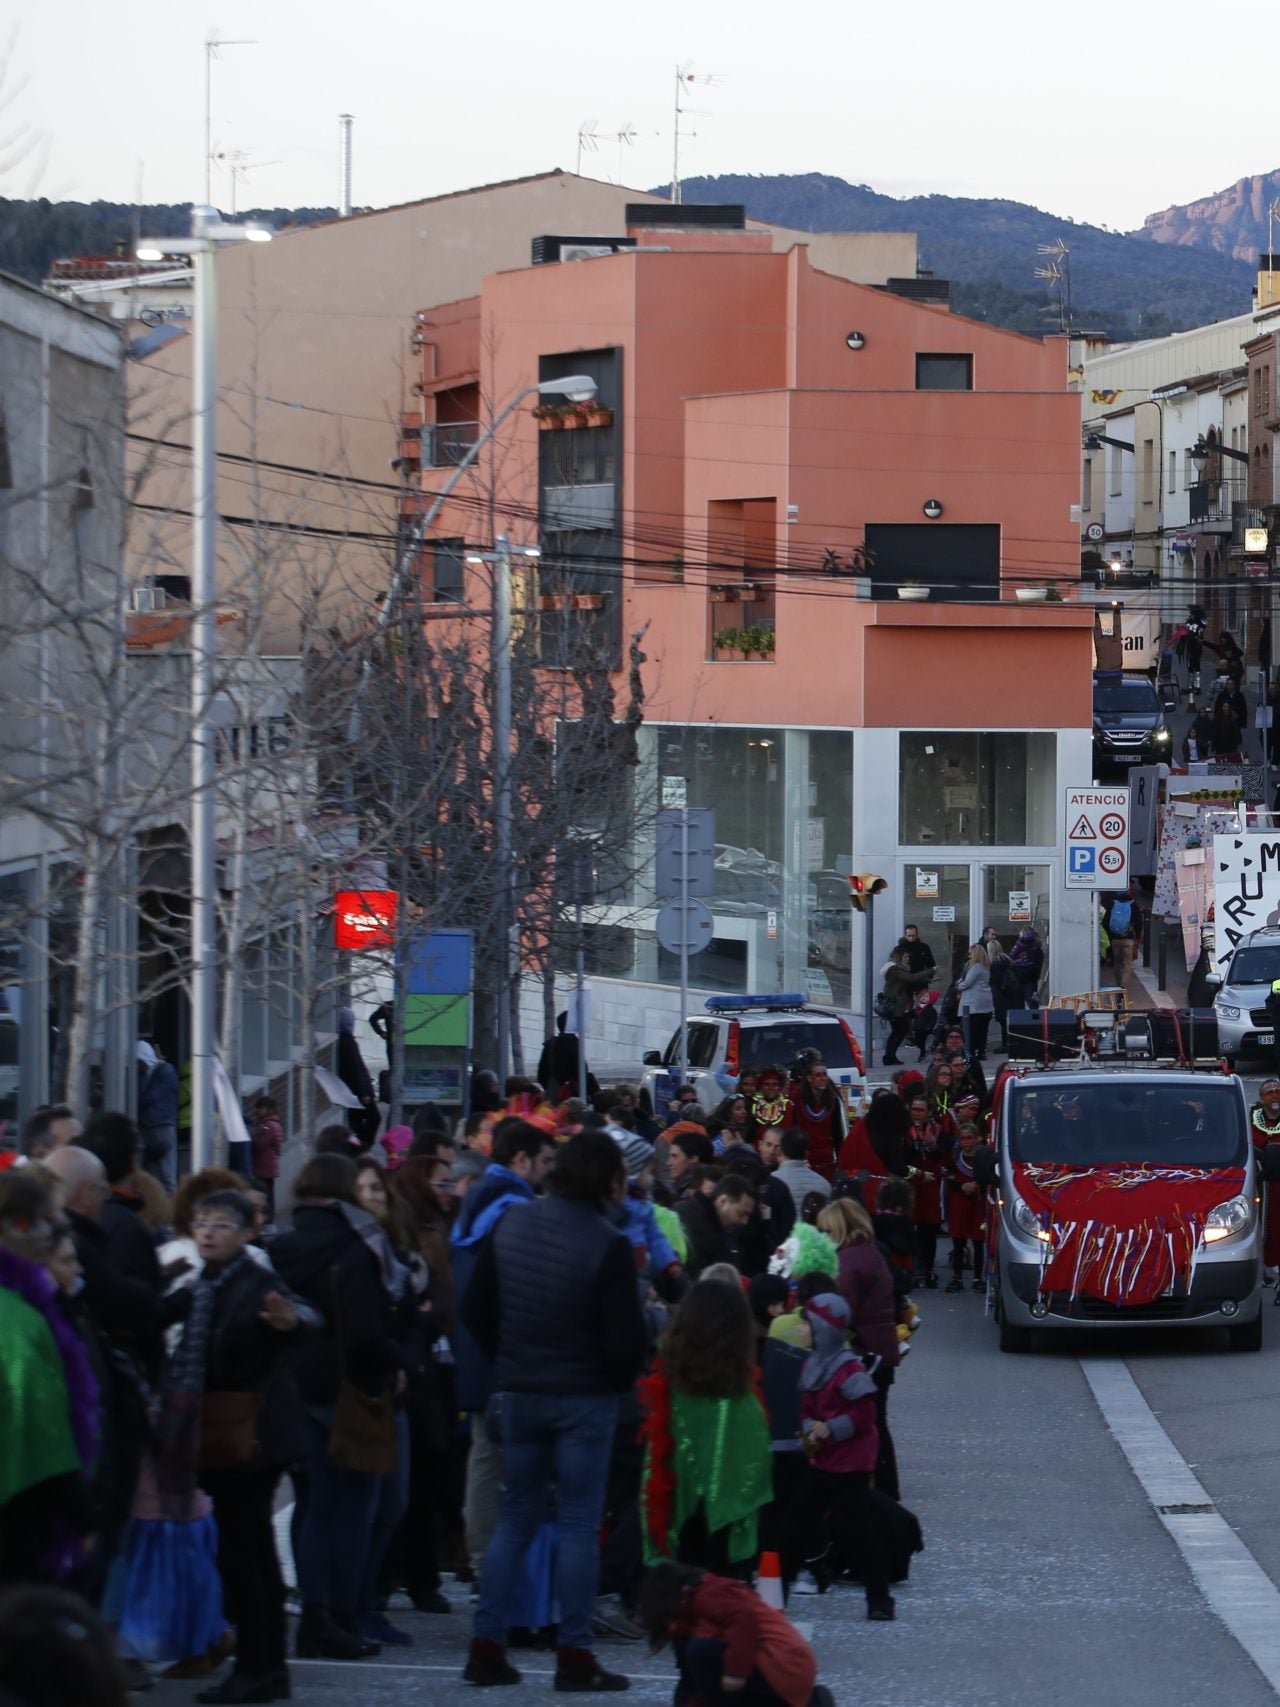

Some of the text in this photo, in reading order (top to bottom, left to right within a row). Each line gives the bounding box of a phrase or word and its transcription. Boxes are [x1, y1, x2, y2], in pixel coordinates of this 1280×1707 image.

[1091, 528, 1101, 536] 30
[1120, 636, 1144, 651] an
[1071, 792, 1126, 806] ATENCIÓ
[1105, 821, 1120, 832] 20
